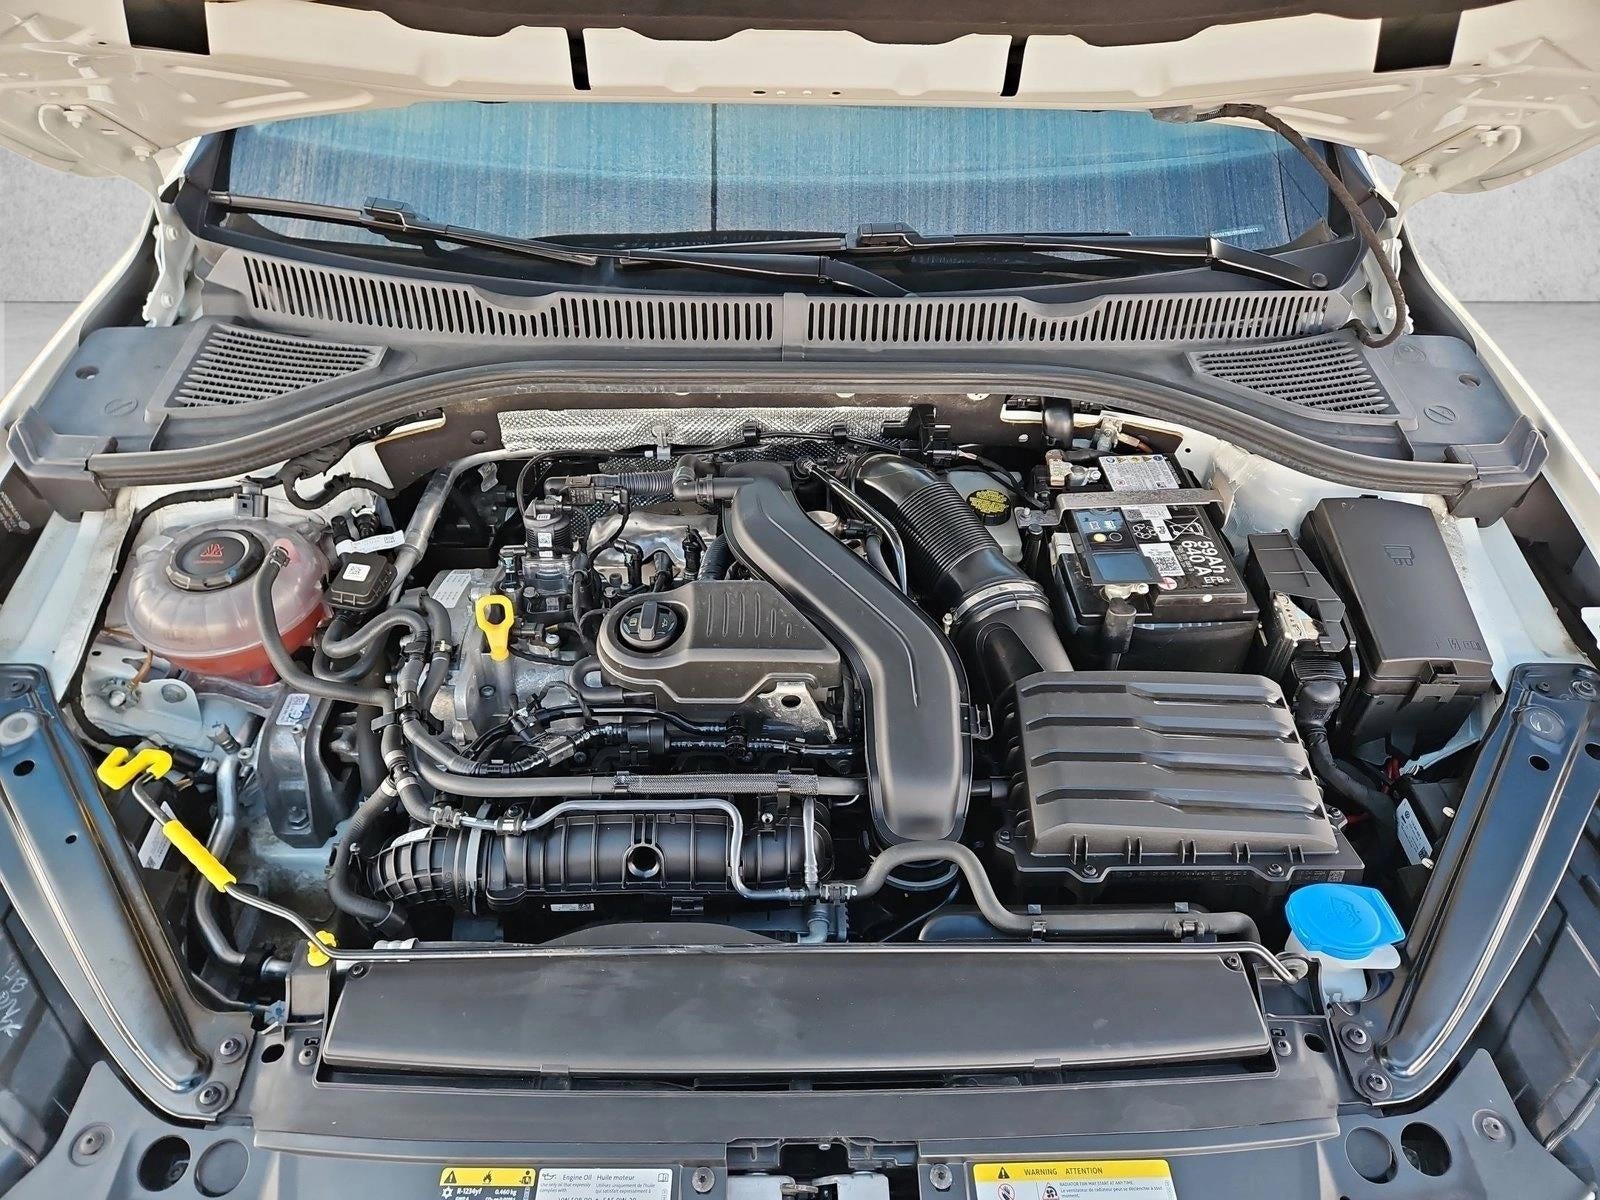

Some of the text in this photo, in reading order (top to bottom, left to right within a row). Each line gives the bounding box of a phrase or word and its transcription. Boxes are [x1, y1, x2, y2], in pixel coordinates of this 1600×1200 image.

[1181, 540, 1206, 563] 640
[1197, 541, 1227, 574] 59Ah
[1193, 566, 1213, 576] A
[1203, 576, 1231, 584] EFB+
[1023, 1167, 1103, 1176] WARNING ATTENTION
[562, 1174, 582, 1182] Engine
[456, 1187, 483, 1197] R-1234yf
[510, 1188, 518, 1197] kg
